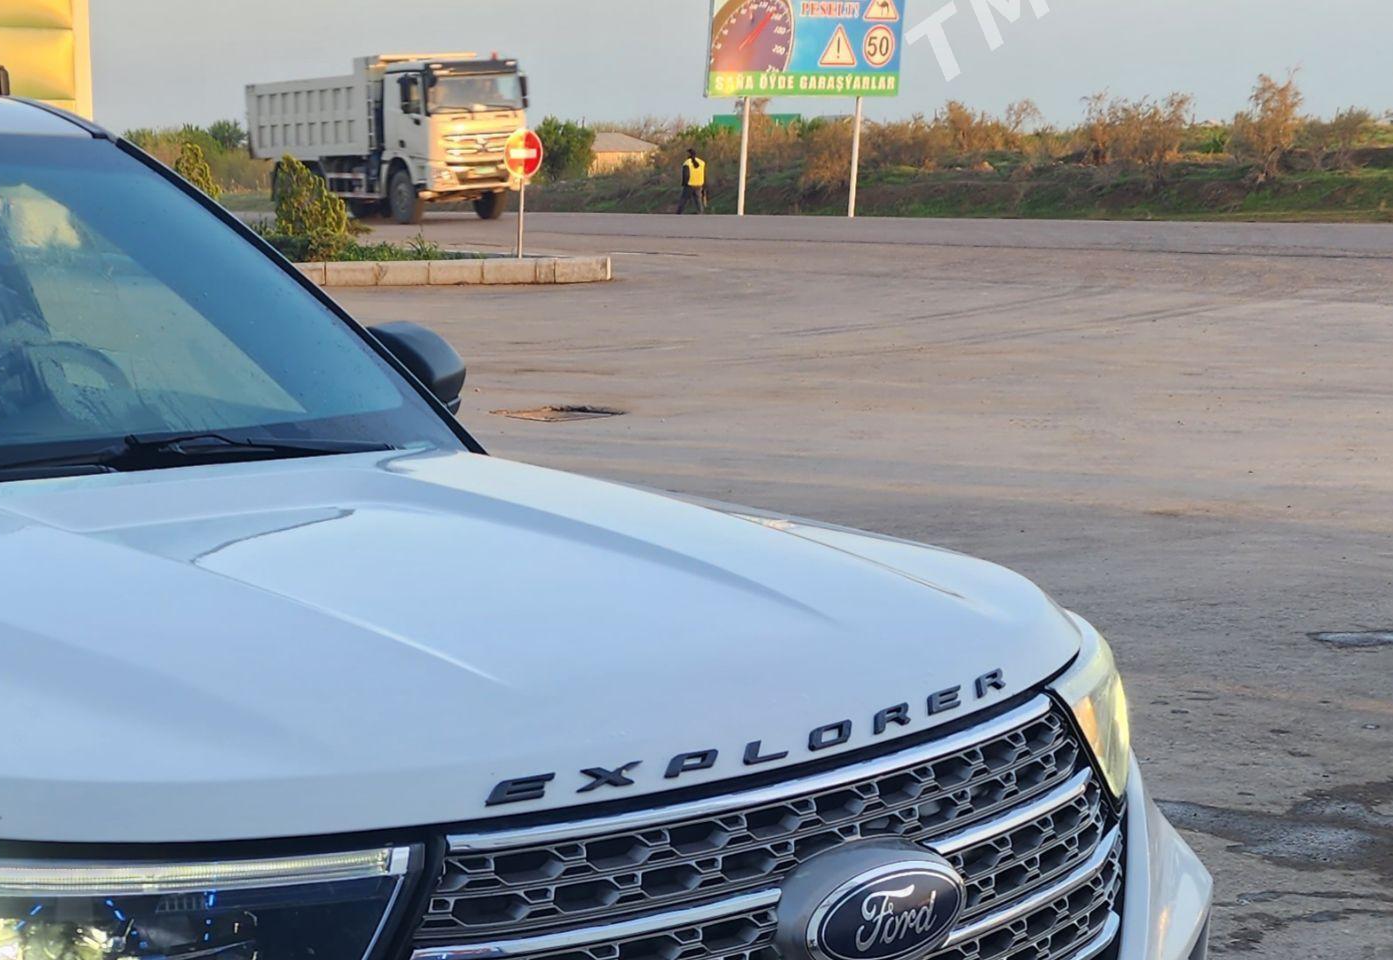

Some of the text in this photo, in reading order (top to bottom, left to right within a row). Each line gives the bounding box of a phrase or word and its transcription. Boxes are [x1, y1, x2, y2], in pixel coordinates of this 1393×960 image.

[867, 36, 889, 57] 50
[485, 667, 1007, 807] EXPLORER
[855, 883, 938, 952] Ford
